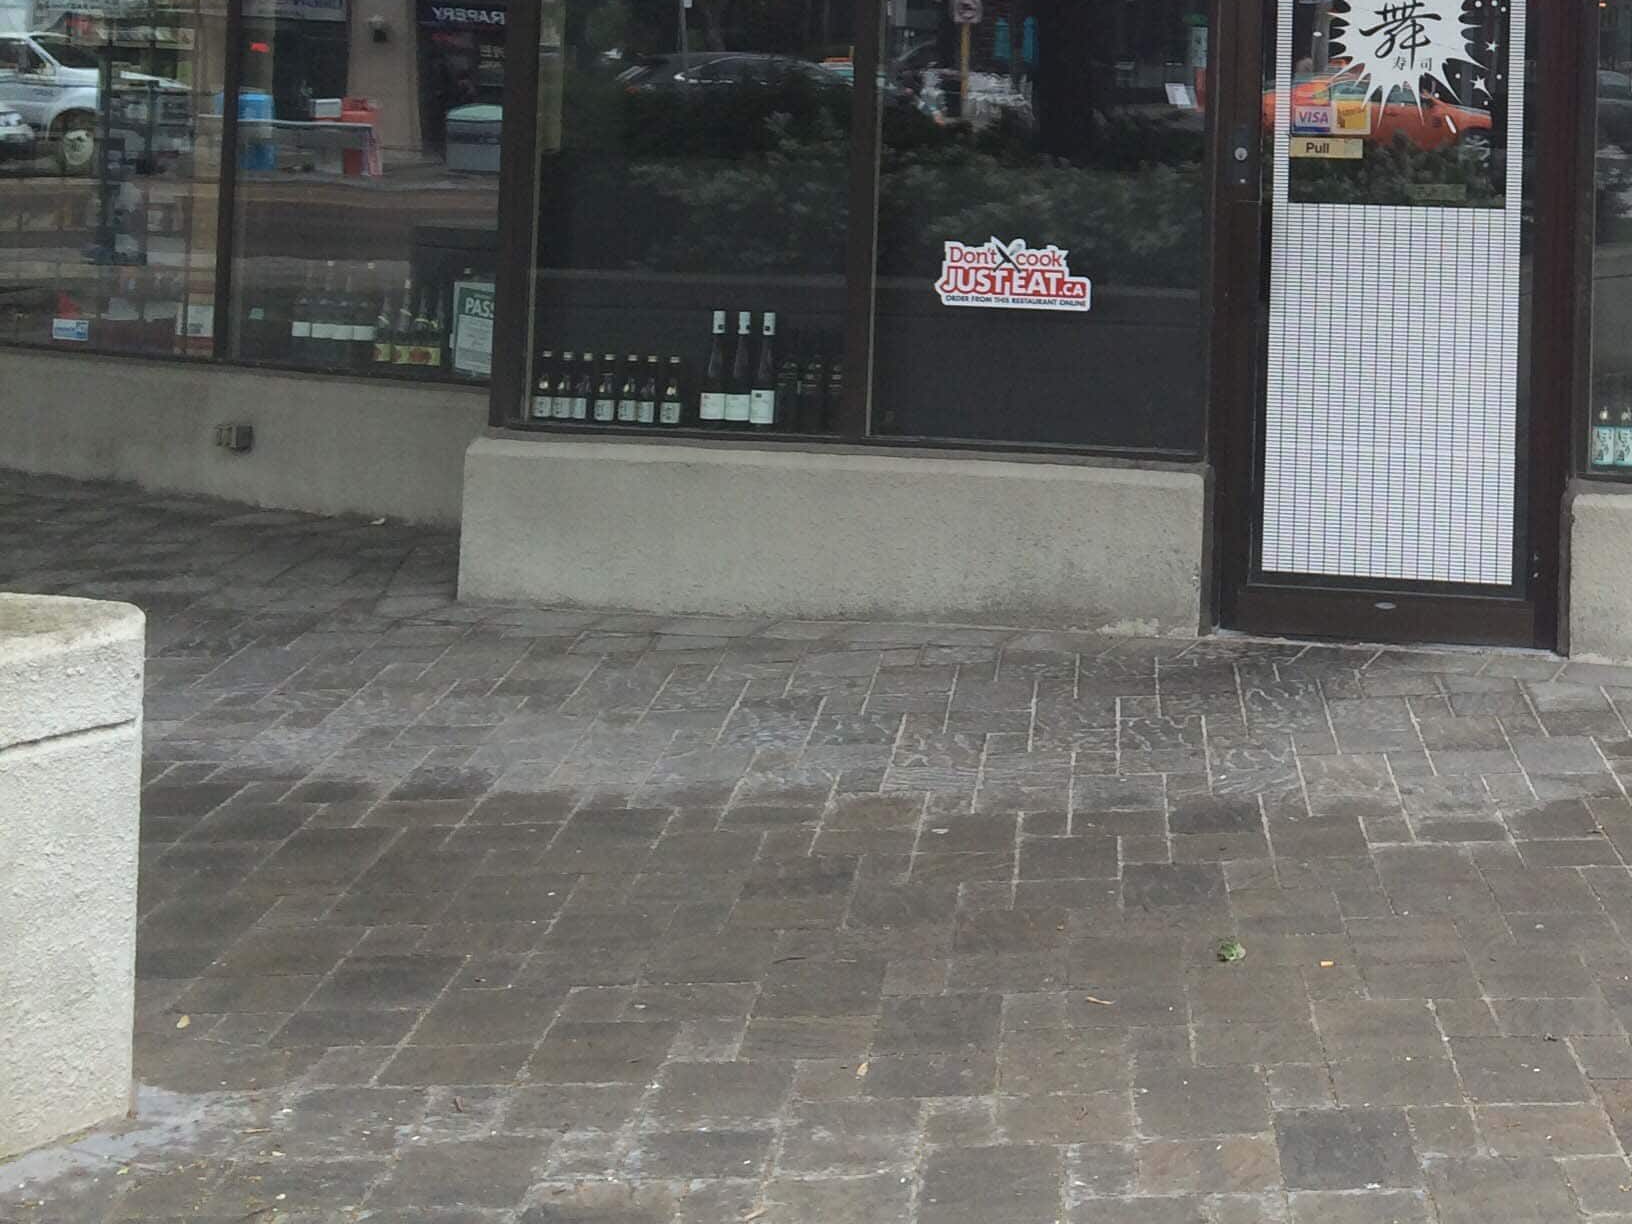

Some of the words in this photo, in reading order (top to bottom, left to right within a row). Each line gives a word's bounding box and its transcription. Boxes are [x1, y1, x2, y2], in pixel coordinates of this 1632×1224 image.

[1299, 111, 1329, 124] VISA
[1306, 142, 1330, 153] Pull
[950, 246, 998, 265] Don't
[1016, 250, 1063, 267] cook
